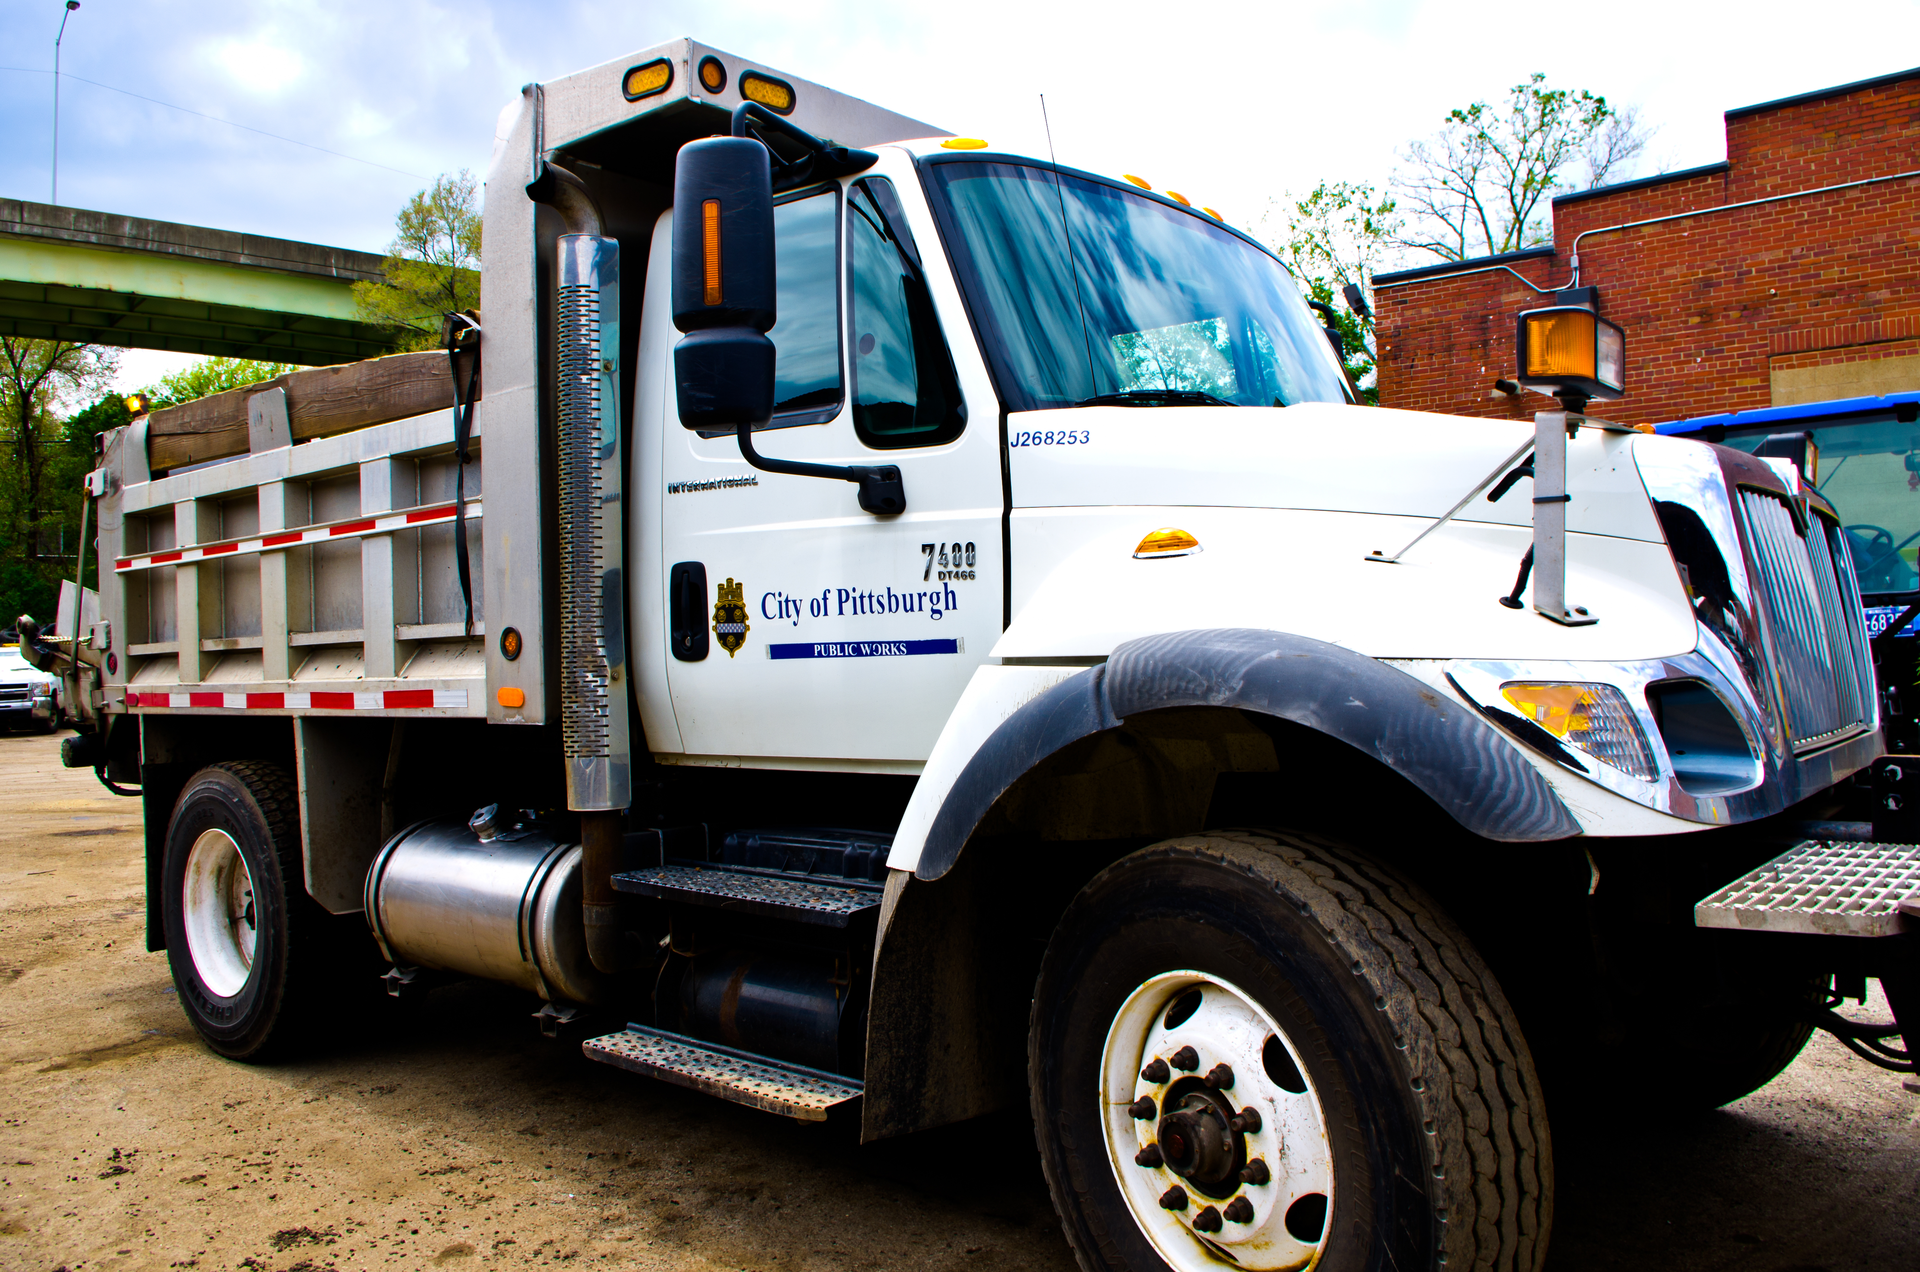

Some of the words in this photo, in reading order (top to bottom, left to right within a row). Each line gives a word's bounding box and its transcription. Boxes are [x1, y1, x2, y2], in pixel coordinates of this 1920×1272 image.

[1010, 430, 1090, 447] J268253
[667, 473, 758, 494] INTERNATIONAL
[921, 540, 976, 581] 7400
[937, 570, 976, 581] DT466
[761, 591, 803, 627] City
[810, 588, 831, 617] of
[836, 582, 958, 620] Pittsburgh
[814, 643, 858, 657] PUBLIC
[860, 642, 907, 656] WORKS
[1225, 927, 1376, 1254] BRIDGESTONE
